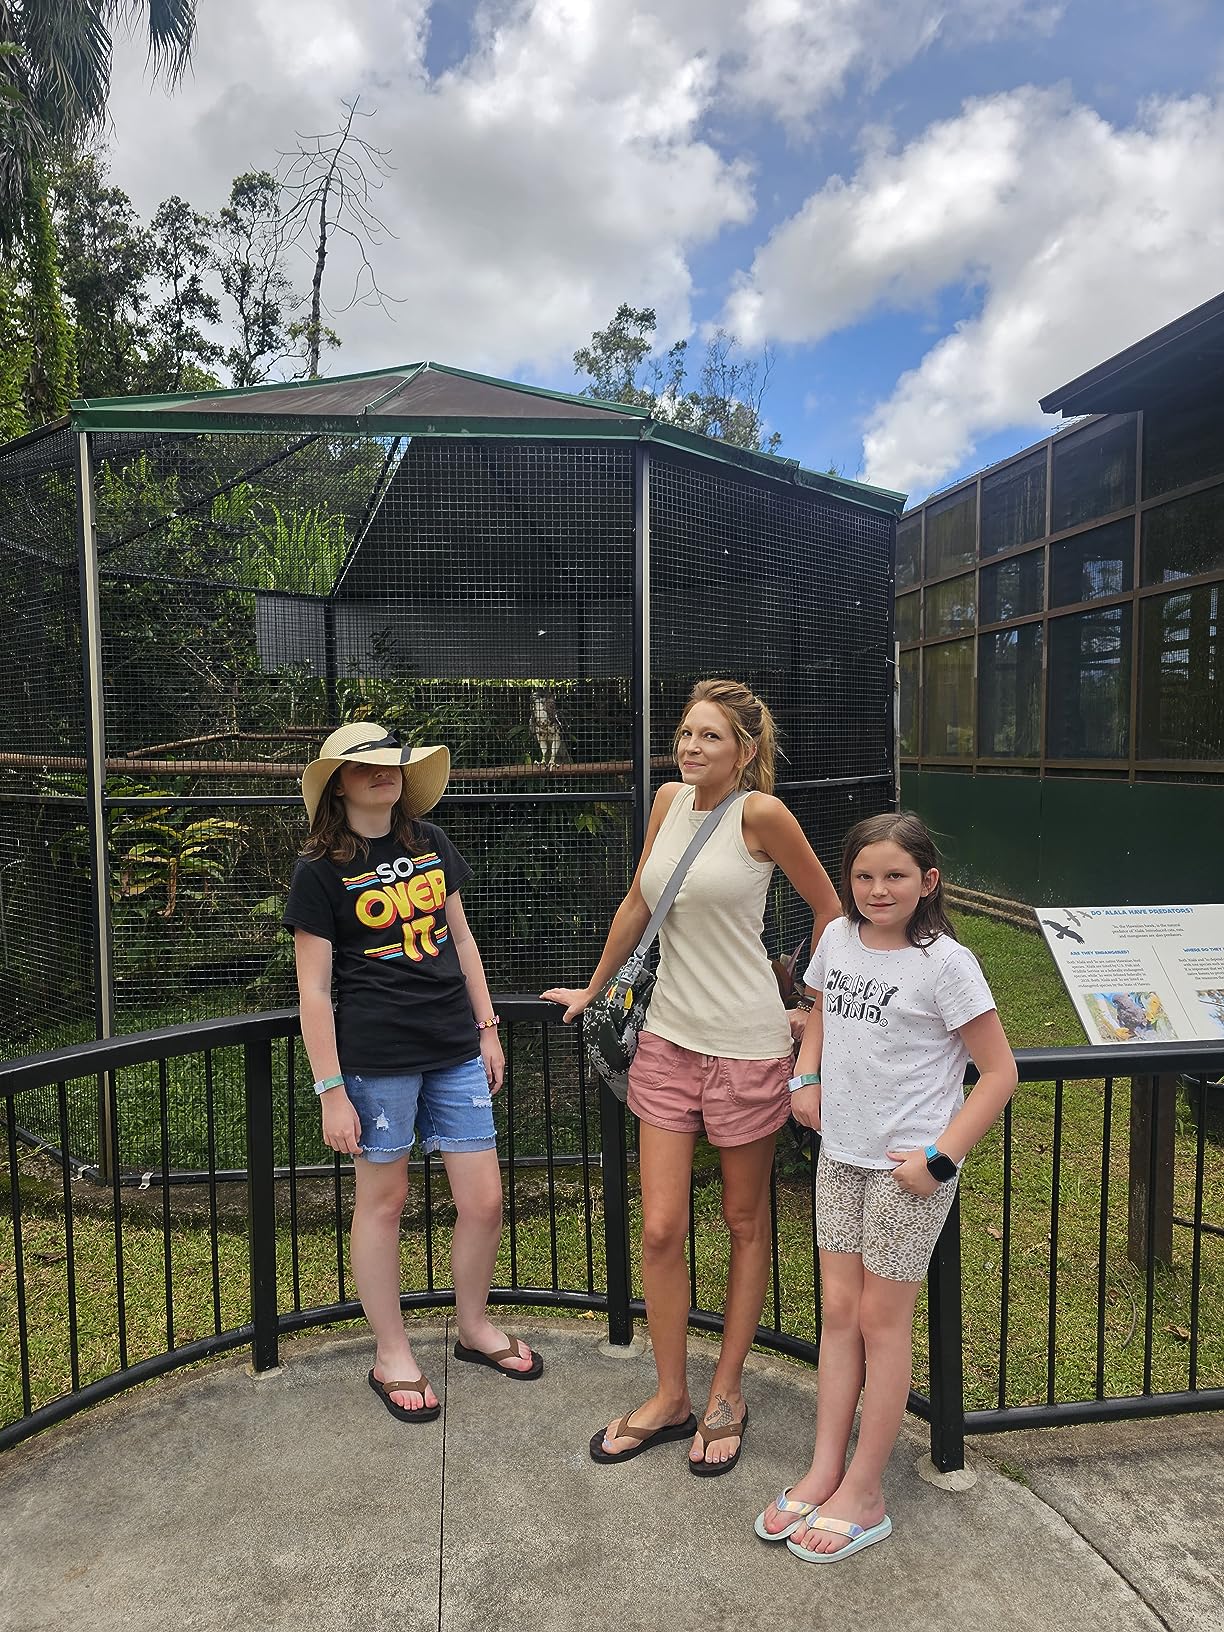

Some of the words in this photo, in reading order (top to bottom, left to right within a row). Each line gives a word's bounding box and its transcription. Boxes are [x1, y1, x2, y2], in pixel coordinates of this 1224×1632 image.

[375, 856, 414, 884] SO
[355, 868, 446, 930] OVER
[401, 914, 440, 962] IT
[825, 968, 900, 1006] HAPPY
